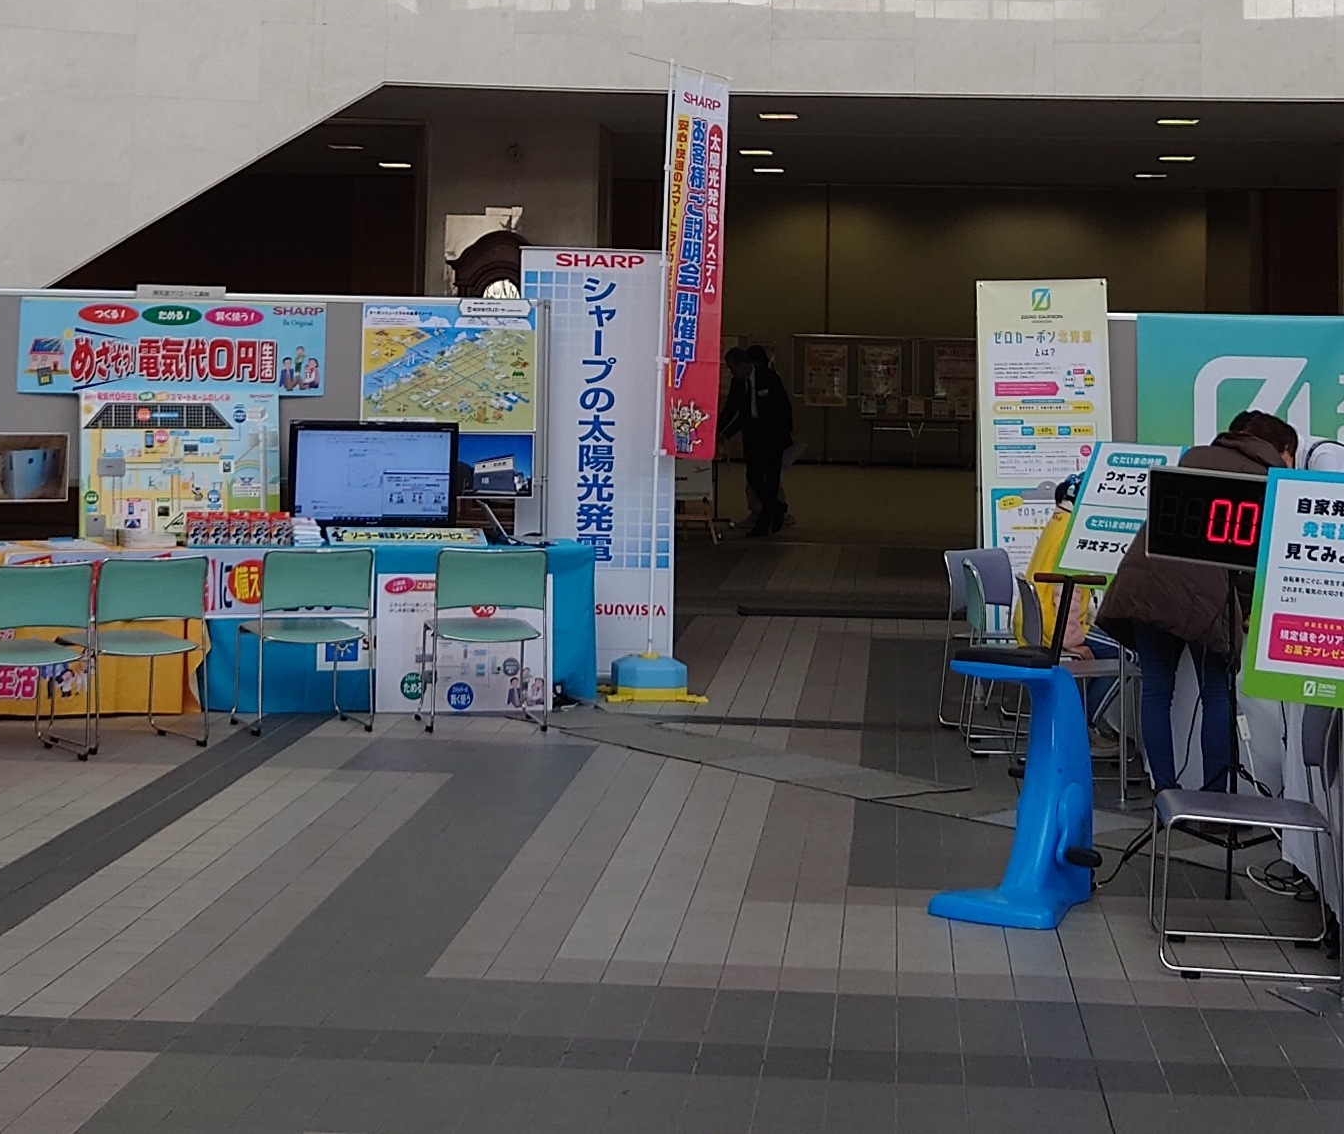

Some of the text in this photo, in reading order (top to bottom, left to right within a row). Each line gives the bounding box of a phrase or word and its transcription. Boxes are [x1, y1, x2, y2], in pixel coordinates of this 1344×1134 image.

[683, 91, 722, 111] SHARP
[703, 133, 723, 294] 太陽光発電システム
[555, 253, 645, 269] SHARP
[273, 306, 324, 316] SHARP
[994, 329, 1092, 344] ゼロカーボン北海道
[575, 276, 617, 563] シャープの太陽光発電
